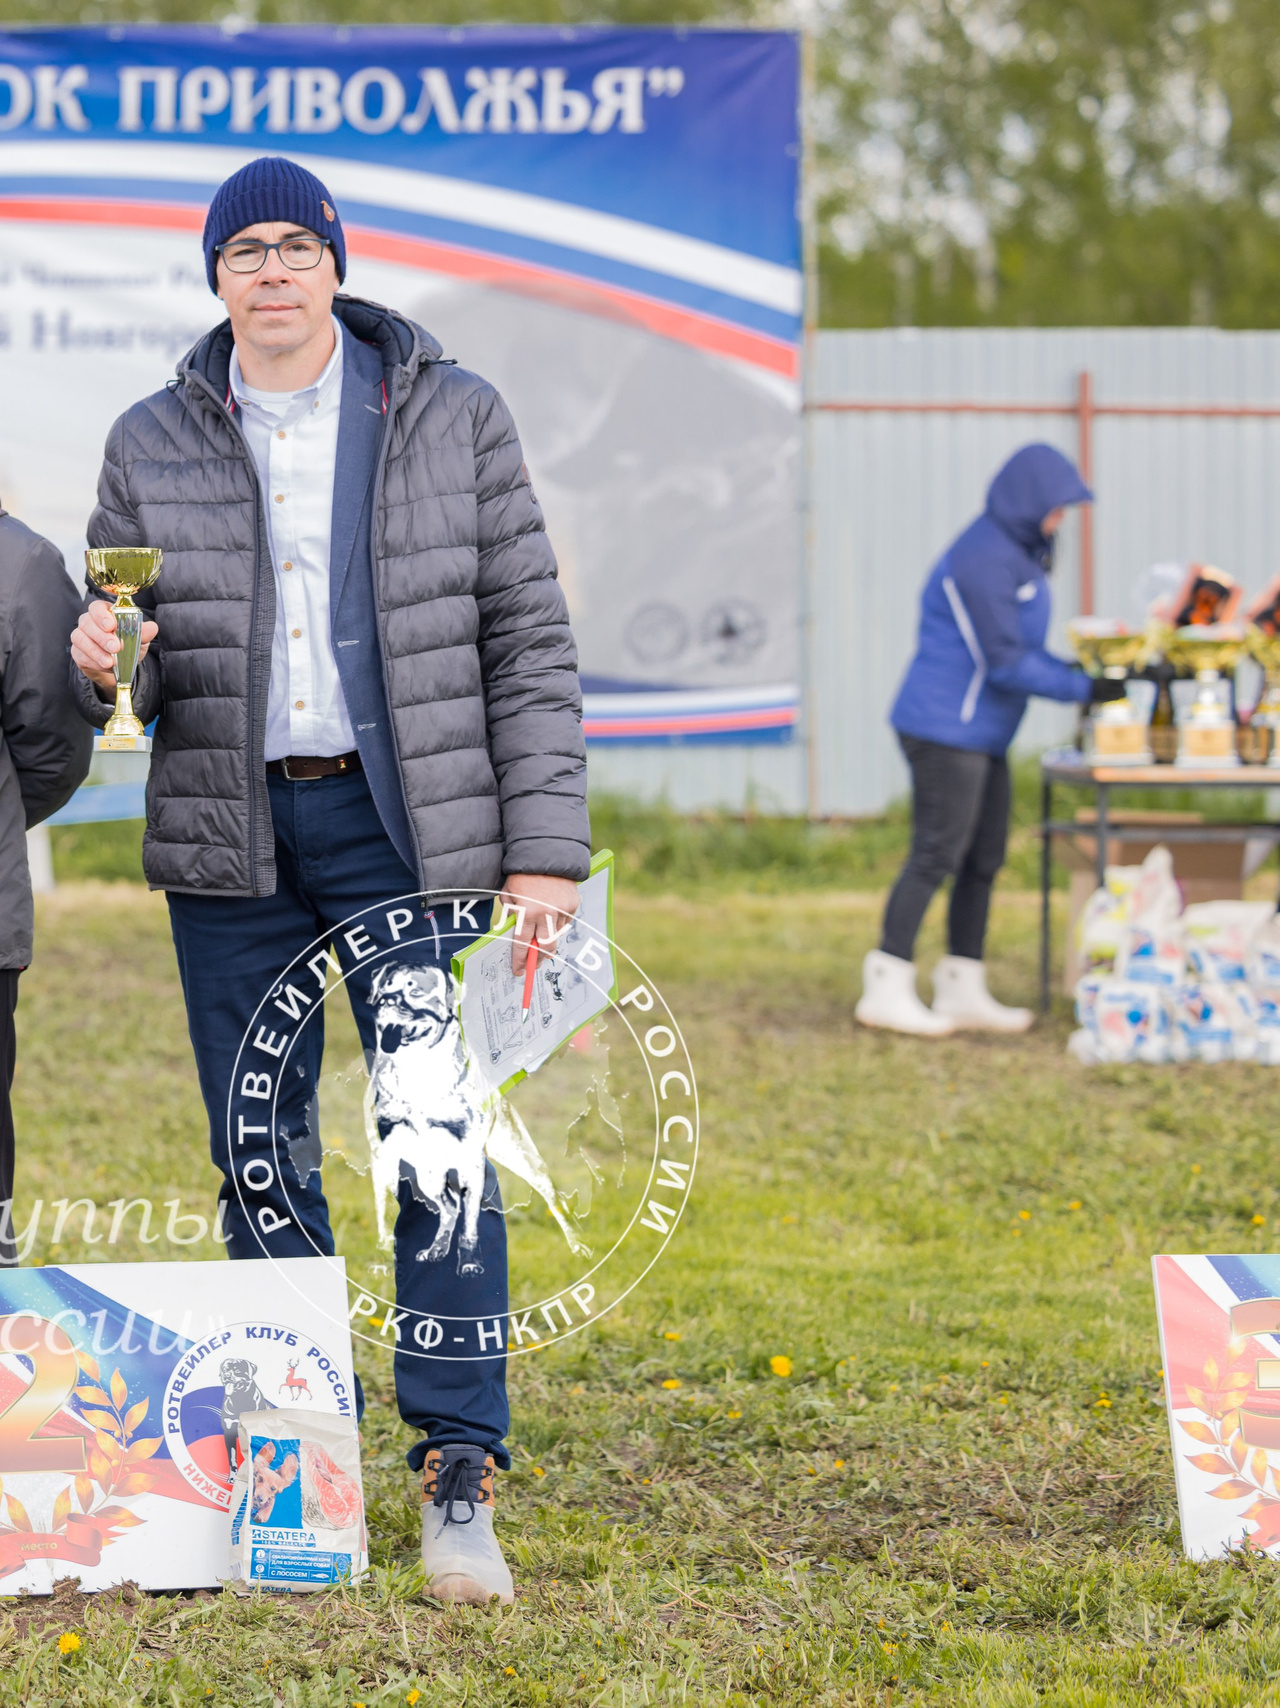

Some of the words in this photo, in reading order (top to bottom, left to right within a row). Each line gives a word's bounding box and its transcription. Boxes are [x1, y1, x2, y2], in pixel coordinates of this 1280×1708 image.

[167, 1331, 232, 1434] РОТВЕЙЛЕР
[245, 1326, 299, 1347] КЛУБ
[262, 1530, 316, 1542] STATERA
[20, 1542, 58, 1551] место
